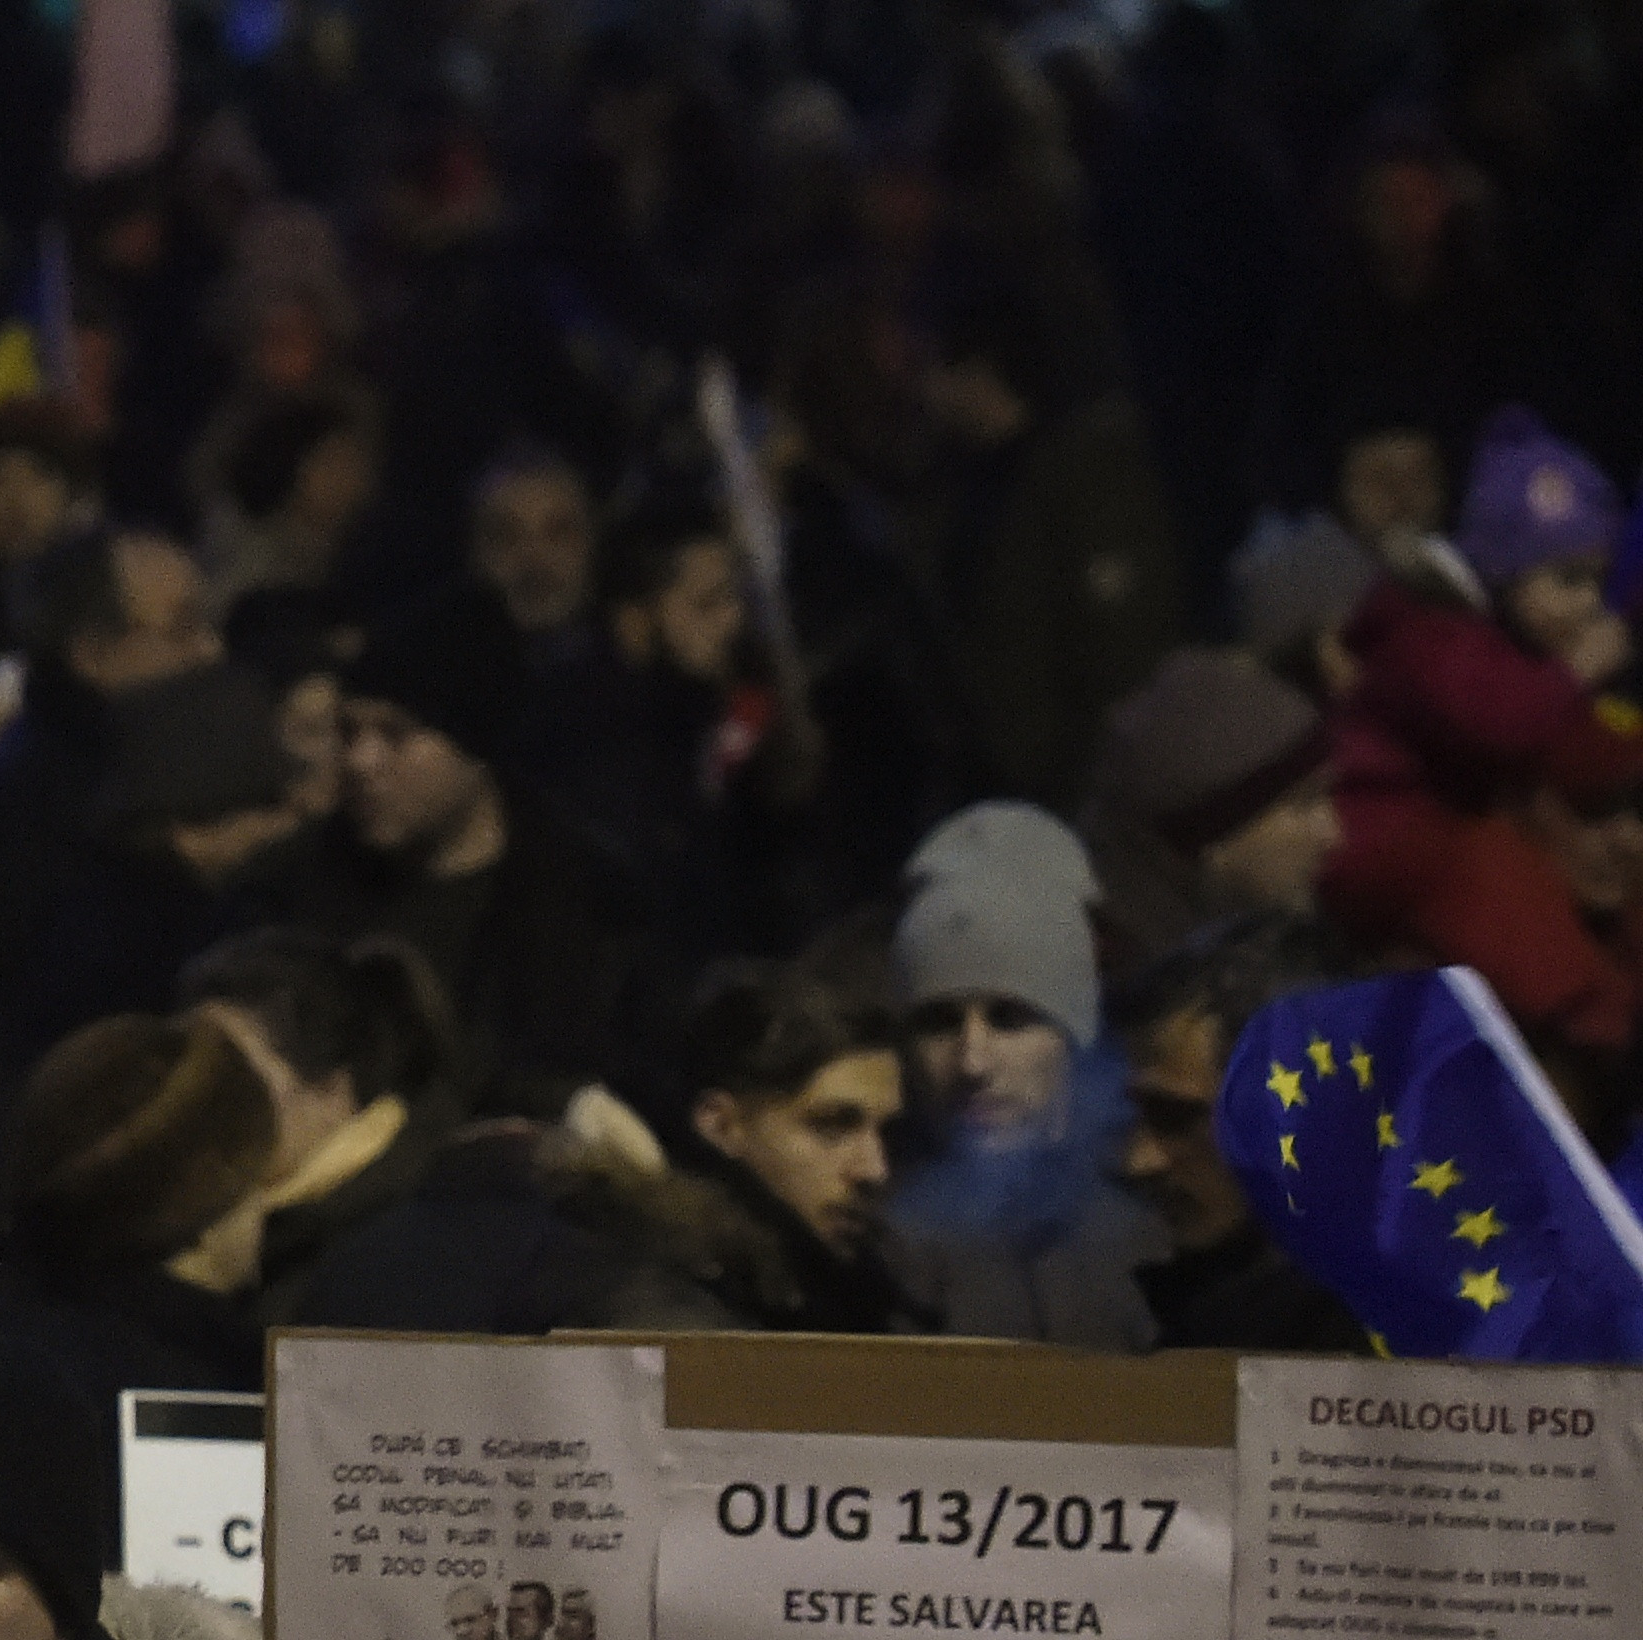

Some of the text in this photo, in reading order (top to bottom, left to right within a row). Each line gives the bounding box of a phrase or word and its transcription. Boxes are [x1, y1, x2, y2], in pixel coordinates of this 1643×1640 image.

[1309, 1396, 1595, 1438] DECALOGUL PSD
[717, 1482, 1179, 1558] OUG 13/2017
[783, 1588, 1103, 1637] ESTE SALVAREA
